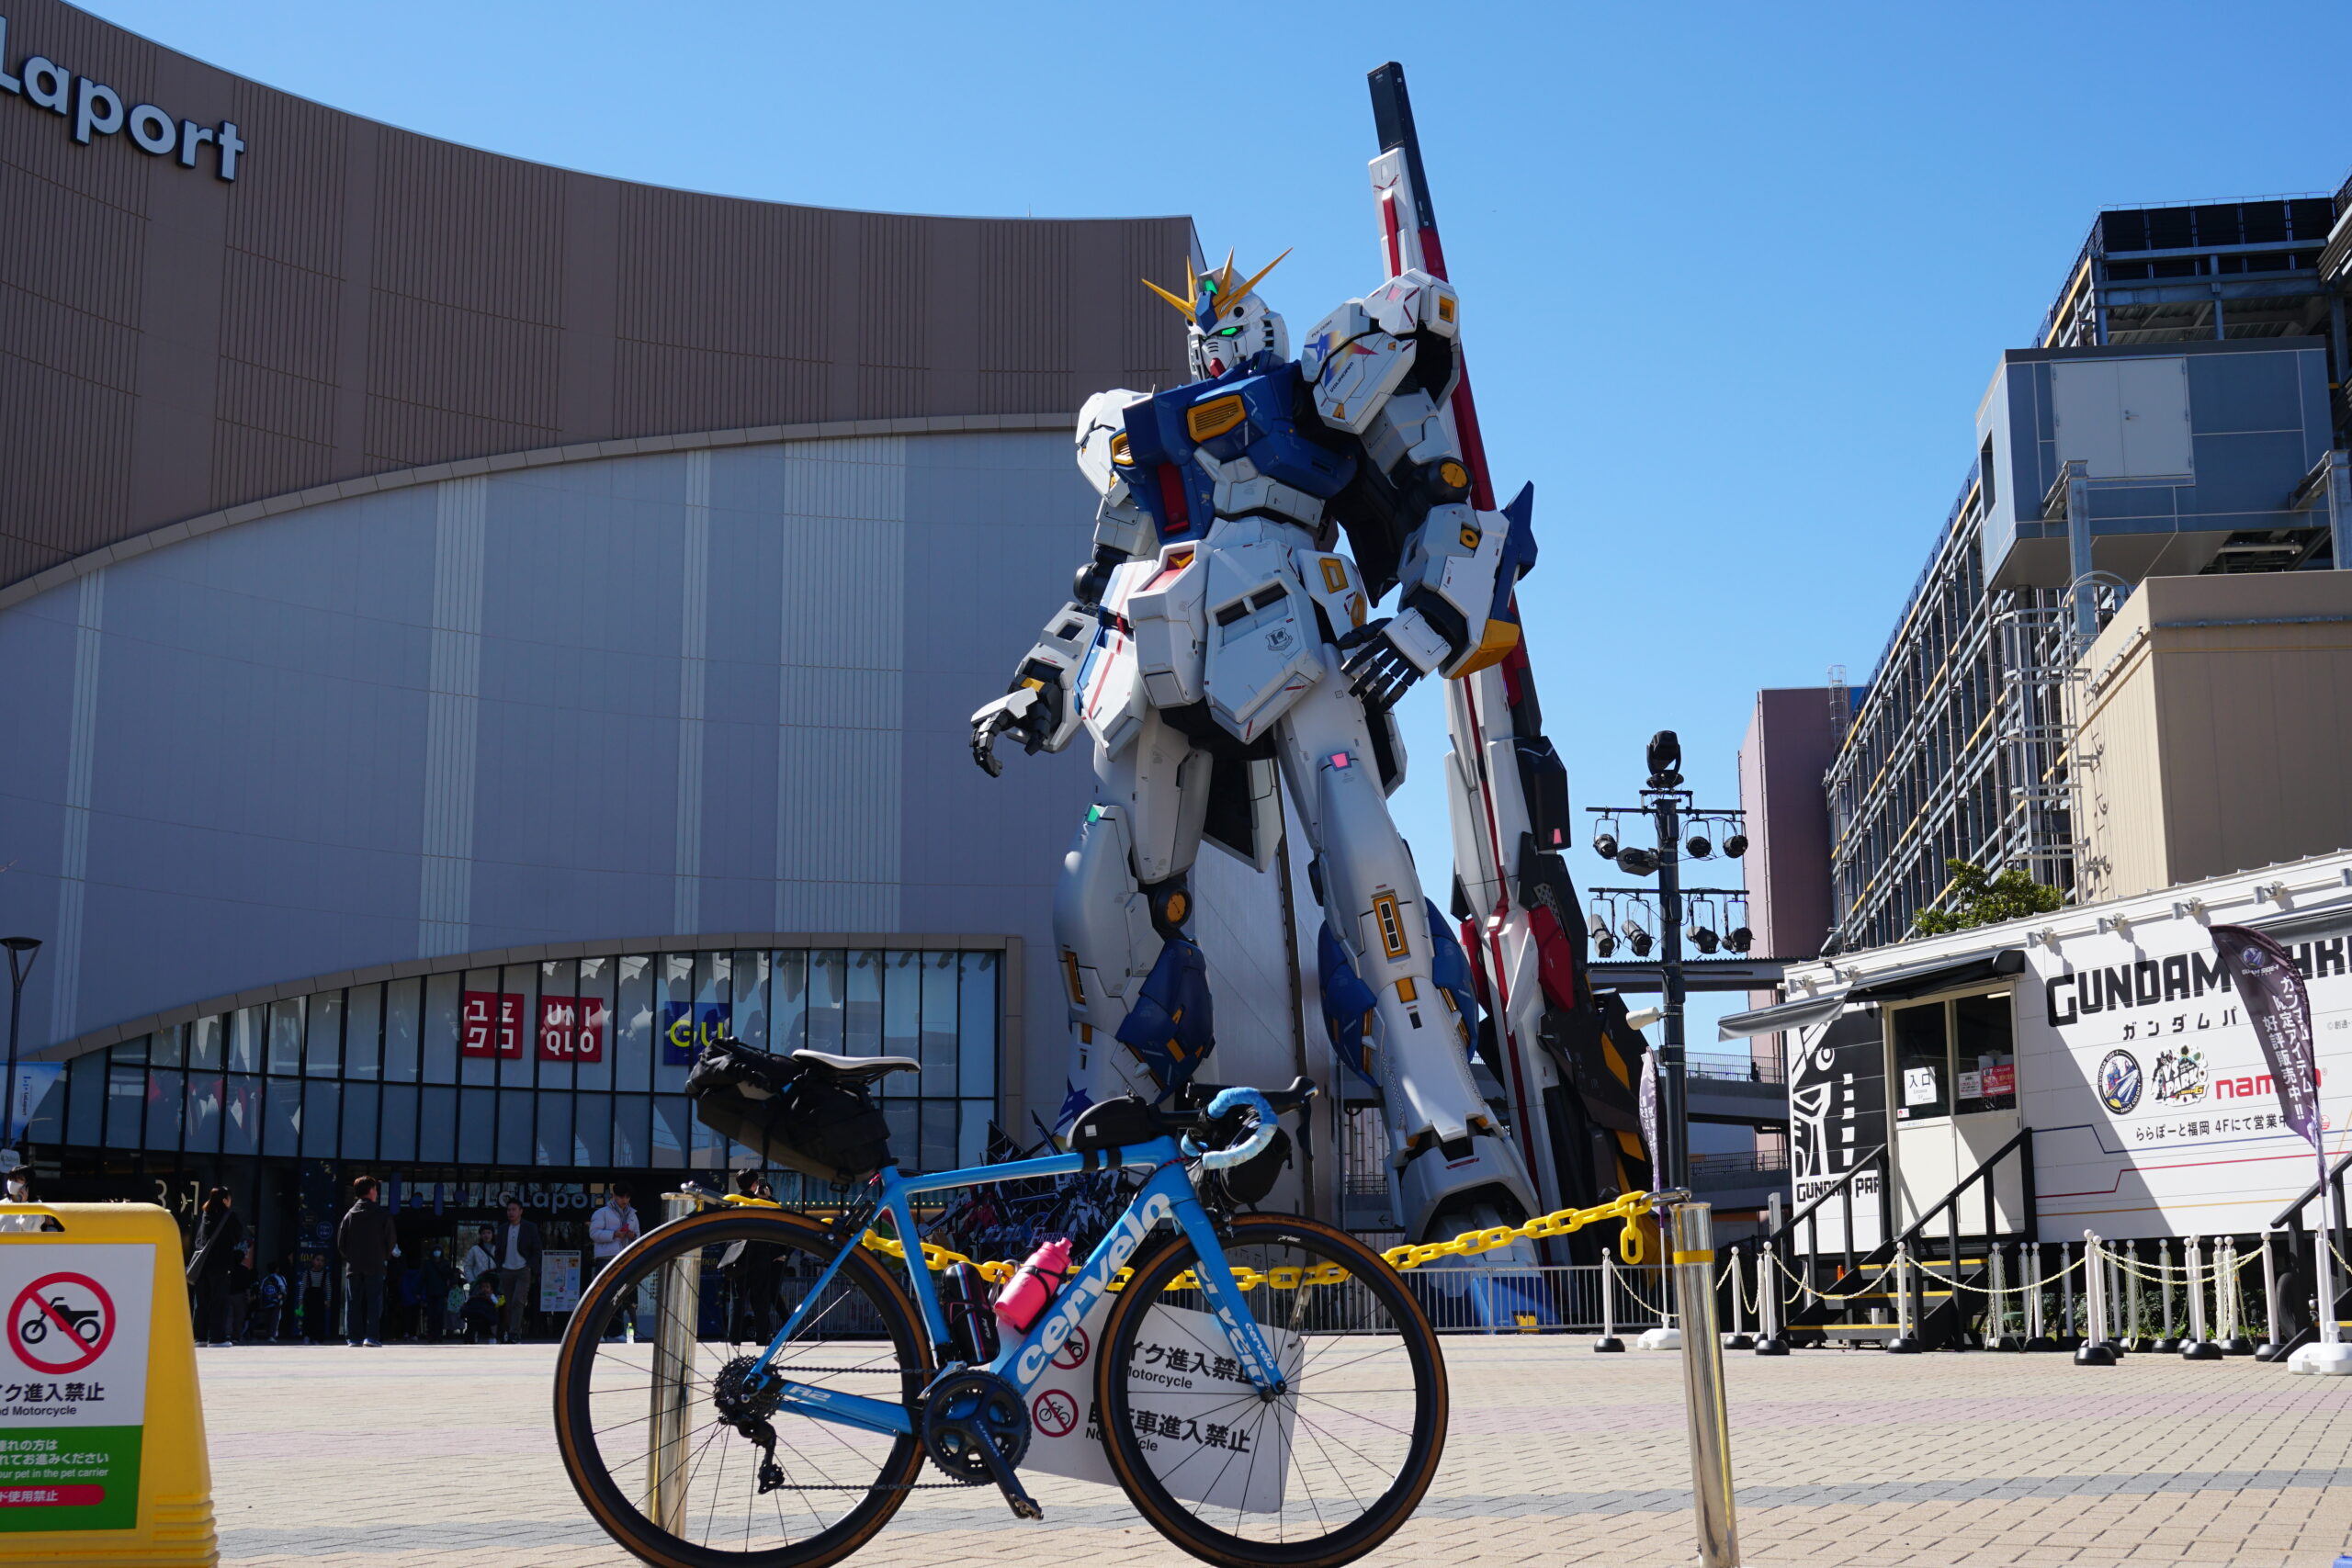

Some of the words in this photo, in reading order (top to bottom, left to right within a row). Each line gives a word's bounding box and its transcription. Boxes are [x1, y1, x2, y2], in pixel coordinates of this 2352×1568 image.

[2046, 952, 2232, 1028] GUNDAM
[547, 1004, 591, 1027] UNI
[546, 1031, 594, 1056] QLO
[669, 1020, 724, 1047] GU
[1909, 1073, 1931, 1089] 入口
[2216, 1067, 2322, 1100] nam
[2135, 1121, 2211, 1142] ららぽーと福岡
[1797, 1180, 1851, 1202] GUNDA
[1016, 1192, 1171, 1385] cervélo
[1245, 1322, 1275, 1370] cervélo
[0, 1382, 105, 1403] ク進入禁止
[12, 1405, 77, 1417] Motorcycle
[15, 1469, 30, 1480] pet
[32, 1469, 41, 1477] in
[43, 1468, 59, 1477] the
[60, 1469, 75, 1480] pet
[78, 1467, 108, 1477] carrier
